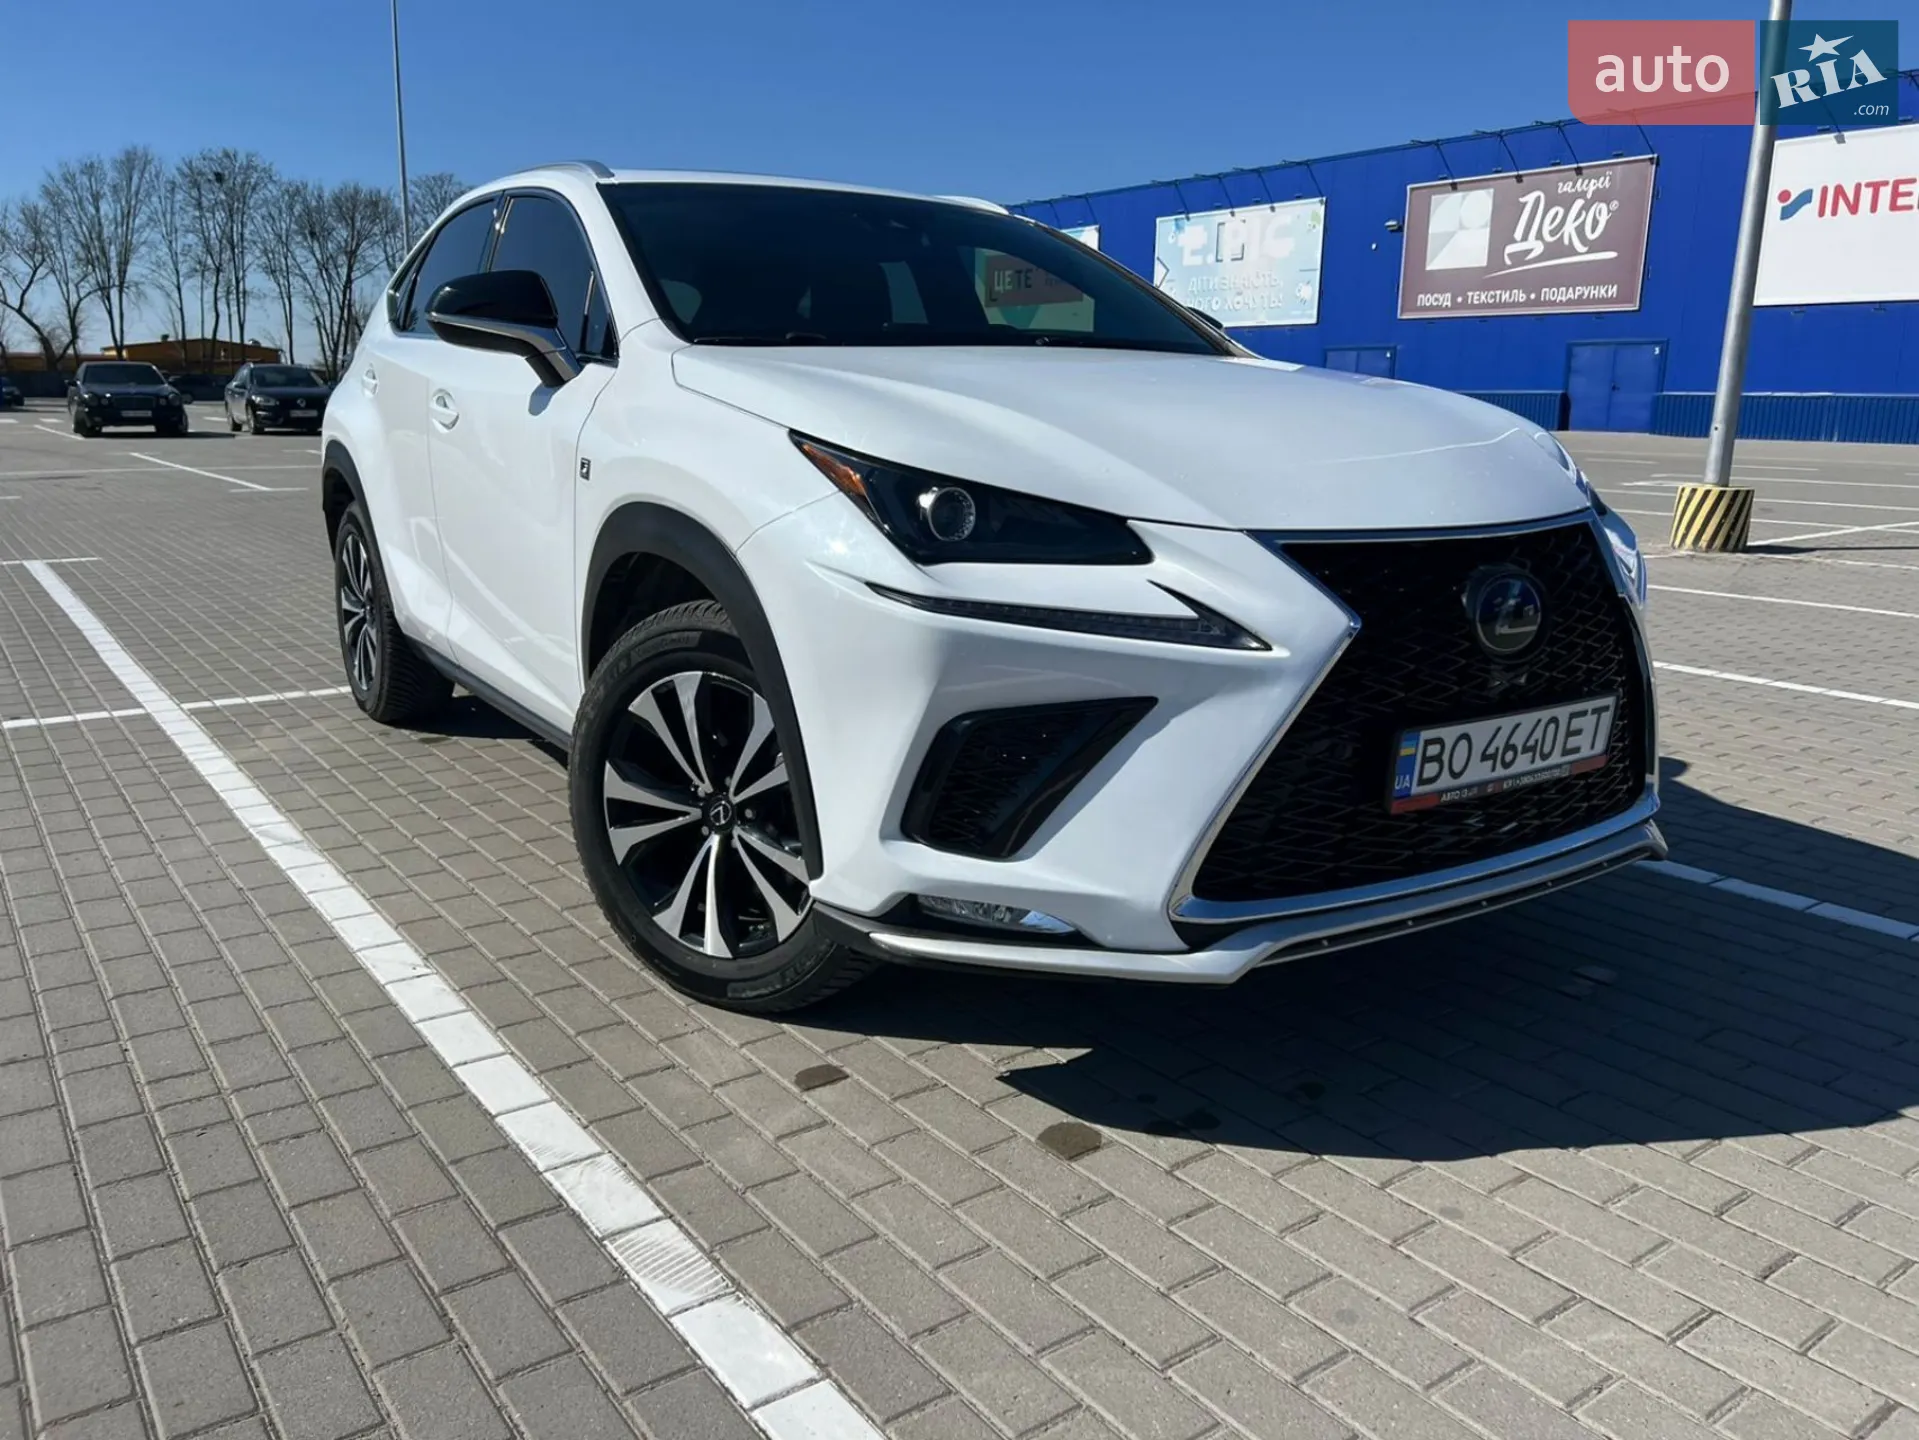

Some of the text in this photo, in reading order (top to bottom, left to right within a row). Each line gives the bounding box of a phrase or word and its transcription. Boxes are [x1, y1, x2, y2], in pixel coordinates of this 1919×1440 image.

[1817, 177, 1919, 219] INTE
[1416, 284, 1619, 308] ПОСУД ТЕКСТИЛЬ ПОДАРУНКИ
[1394, 775, 1411, 790] UA
